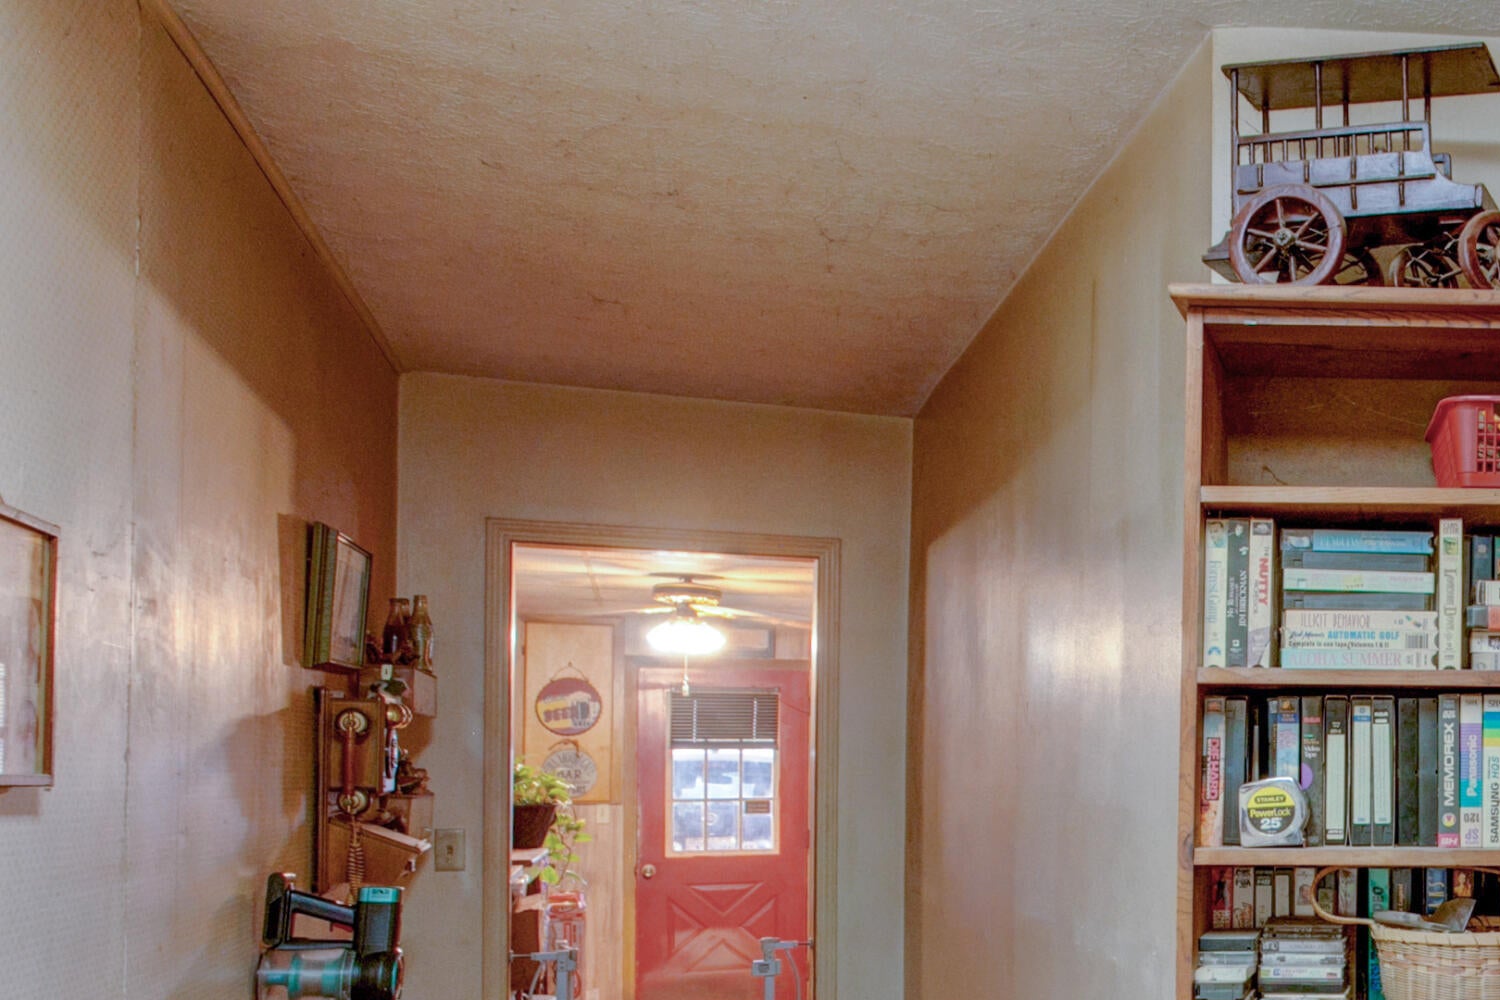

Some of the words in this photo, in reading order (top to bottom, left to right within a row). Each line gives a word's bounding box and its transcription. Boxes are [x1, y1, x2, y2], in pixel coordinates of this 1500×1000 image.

[1259, 557, 1270, 607] NUTTY
[1327, 631, 1376, 640] AUTOMATIC
[1379, 631, 1400, 641] GOLF
[1341, 652, 1401, 666] SUMMER
[1443, 722, 1455, 807] MEMOREX
[1465, 733, 1478, 797] Panasonic
[1250, 807, 1292, 818] PowerLock
[1260, 818, 1282, 830] 25
